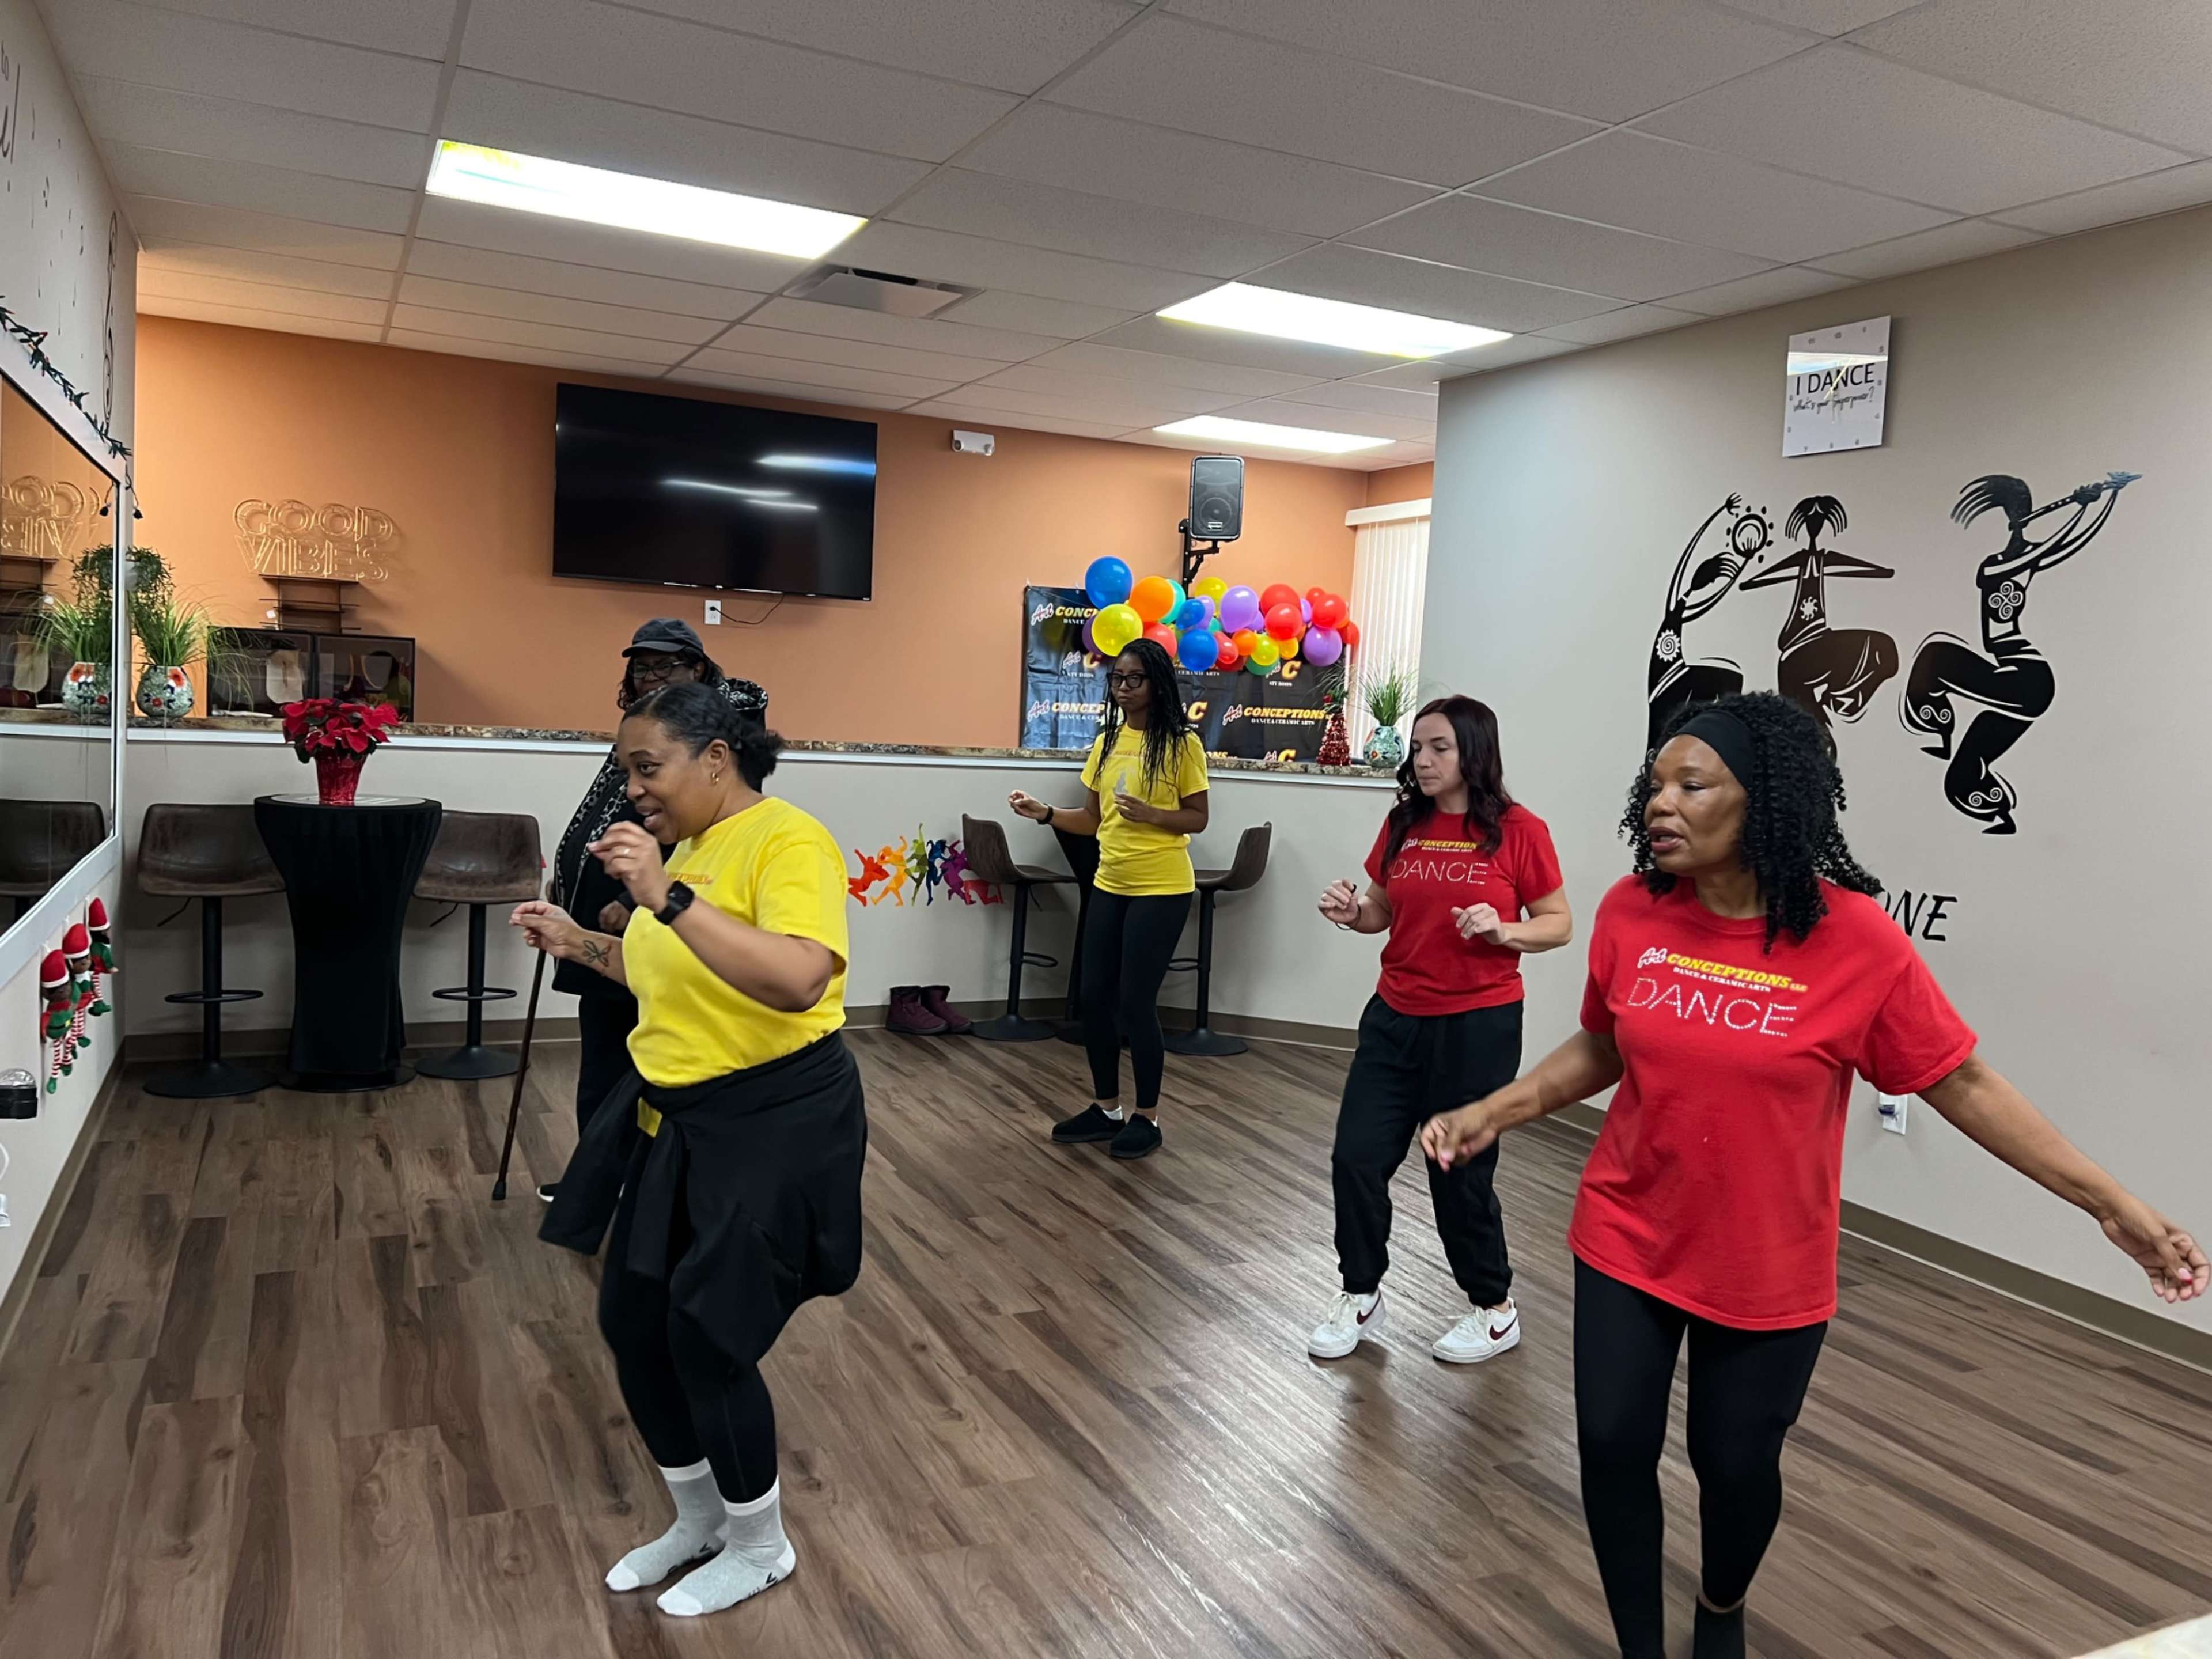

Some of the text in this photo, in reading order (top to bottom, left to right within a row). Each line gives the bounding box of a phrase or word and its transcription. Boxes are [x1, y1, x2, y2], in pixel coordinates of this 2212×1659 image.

[1796, 362, 1875, 396] I DANCE
[234, 499, 393, 542] GOOD
[234, 533, 389, 581] VIBES
[1244, 707, 1326, 719] CONCEPTIONS
[1418, 840, 1478, 849] CONCEPTION
[1391, 858, 1488, 885] DANCE
[1667, 953, 1793, 990] CONCEPTIONS
[1672, 966, 1700, 978] DANCE
[1707, 976, 1748, 989] CERAMIC
[1748, 983, 1771, 993] ARTS
[1627, 977, 1797, 1037] DANCE
